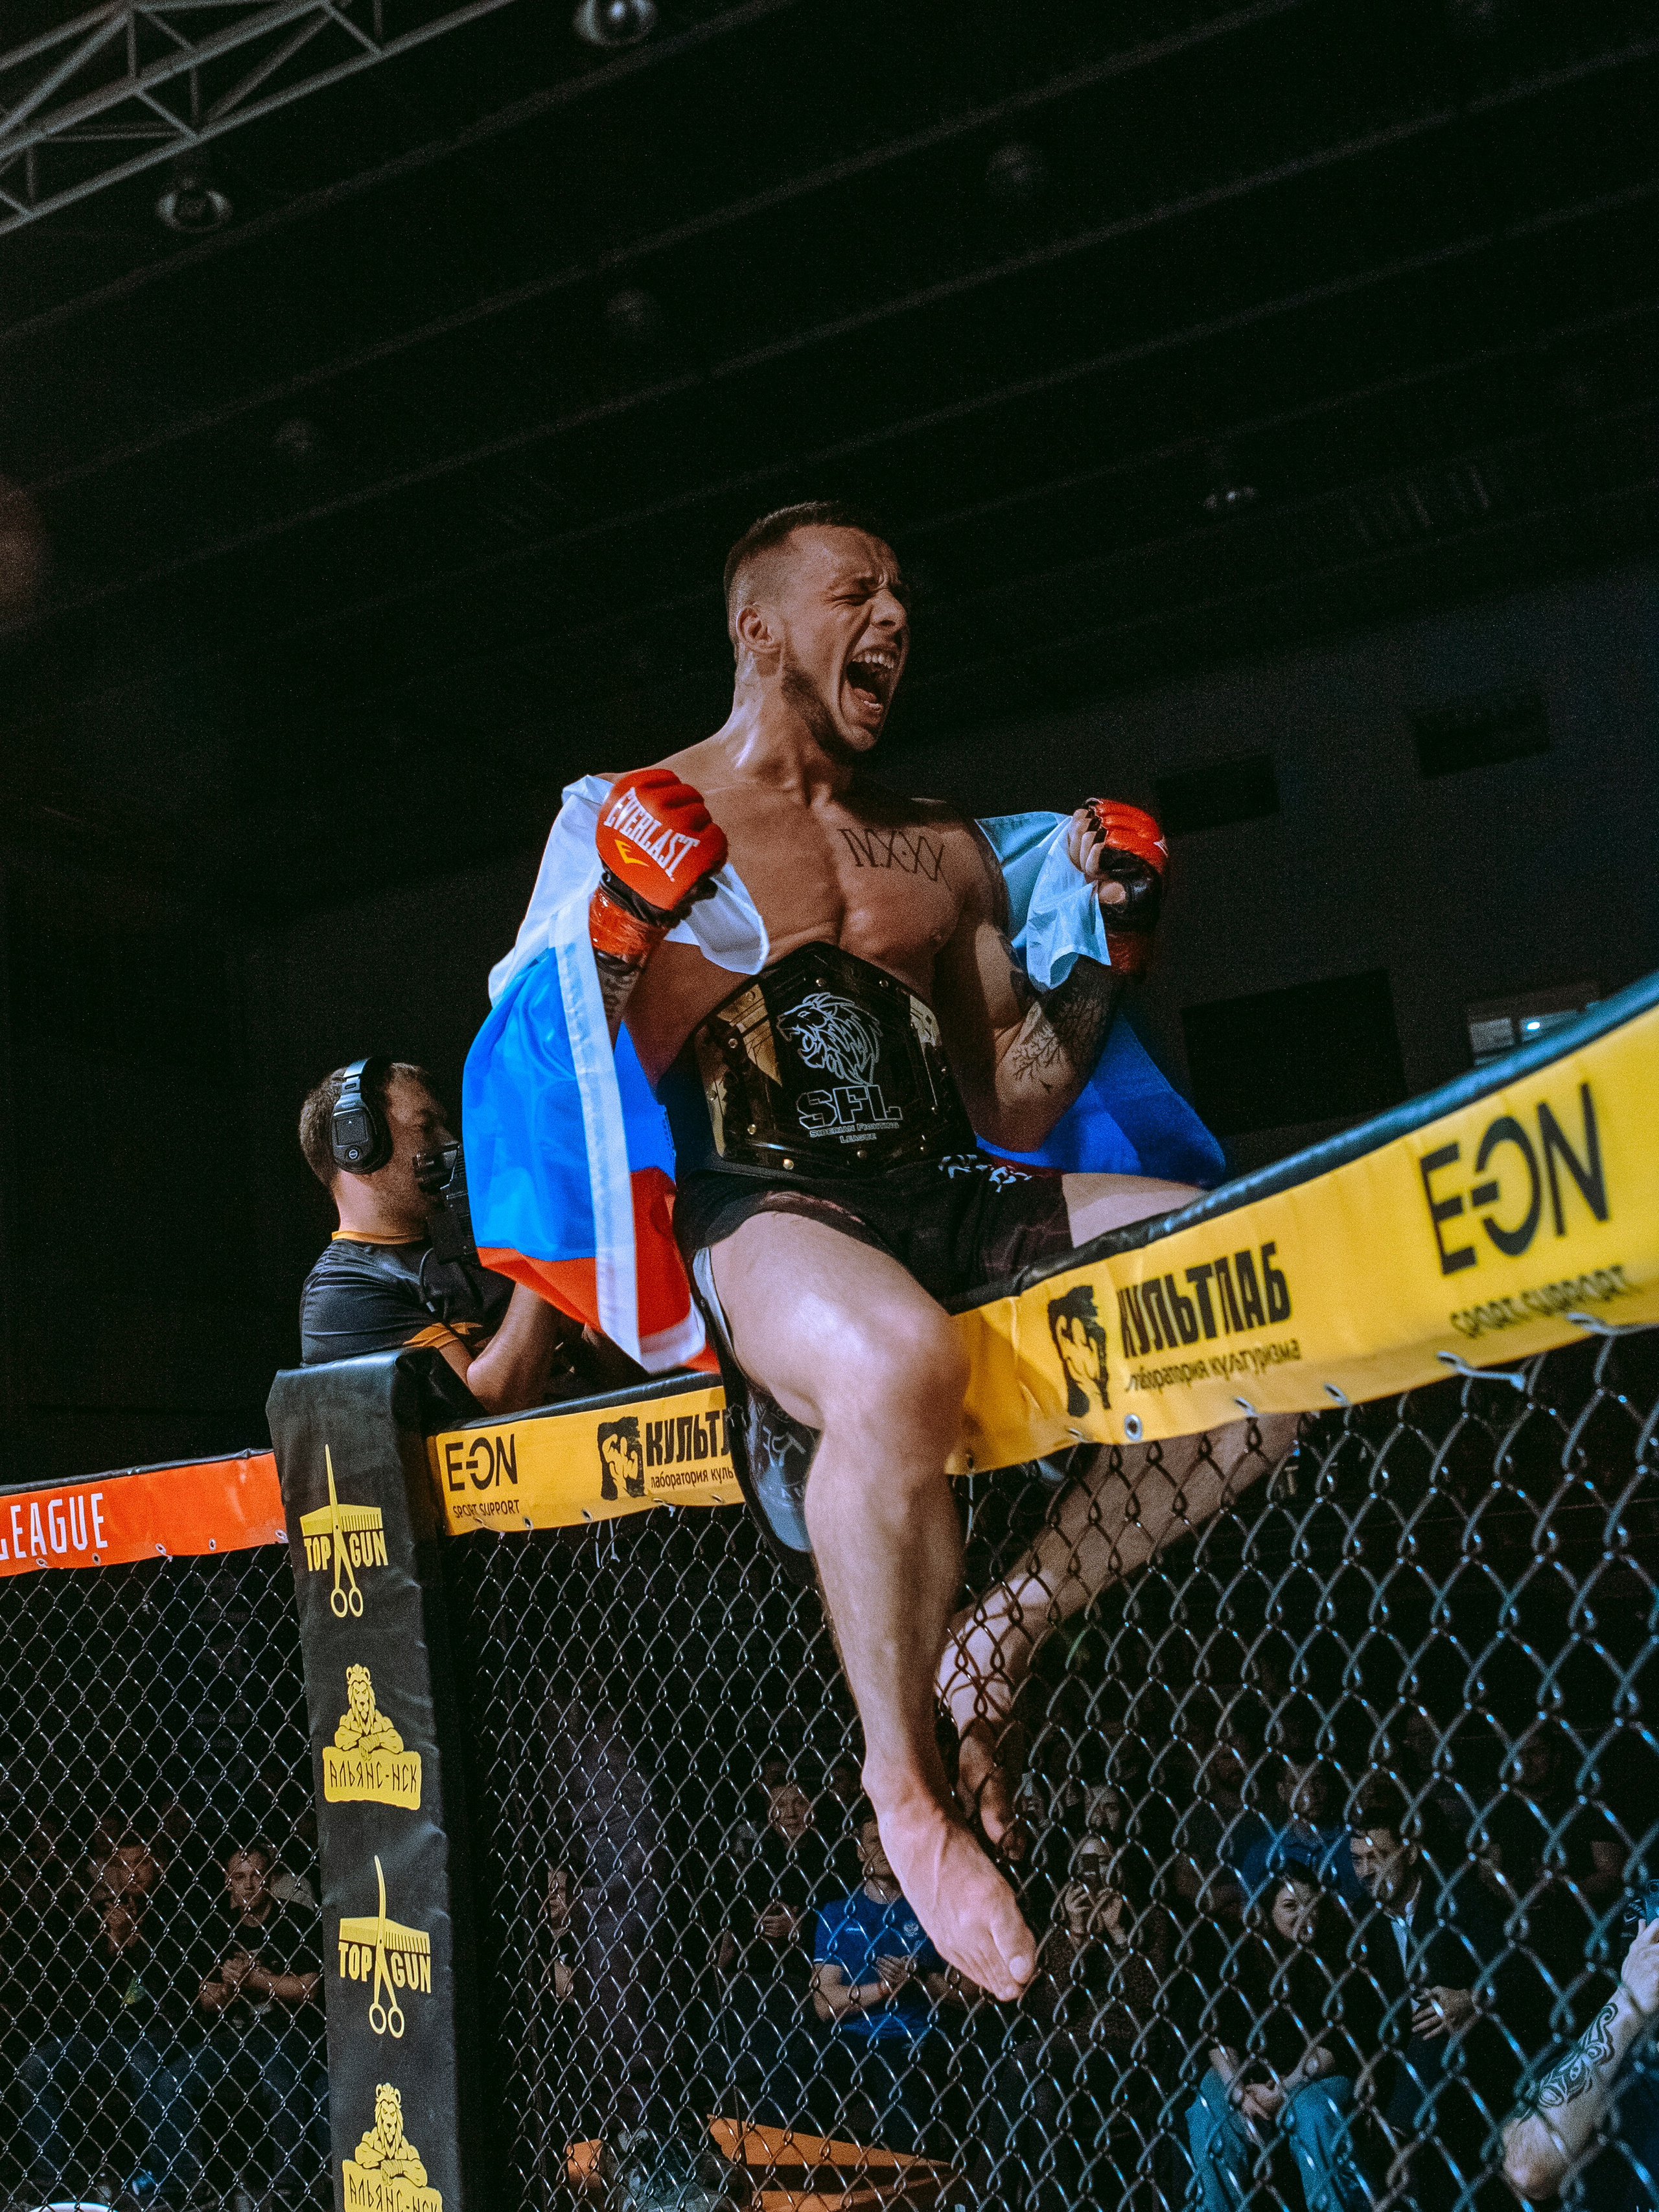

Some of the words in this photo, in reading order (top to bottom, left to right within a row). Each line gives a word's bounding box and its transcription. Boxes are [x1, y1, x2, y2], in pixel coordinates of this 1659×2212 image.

[603, 787, 701, 880] EVERLAST
[796, 1084, 903, 1130] SFL
[651, 1470, 709, 1490] лаборатория
[711, 1467, 735, 1484] куль
[453, 1504, 477, 1519] SPORT
[479, 1499, 520, 1516] SUPPORT
[303, 1535, 332, 1572] TOP
[349, 1530, 389, 1568] GUN
[329, 1759, 417, 1793] АЛЬЯНС-НСК
[338, 1941, 373, 1982] TOP
[390, 1951, 432, 1994] GUN
